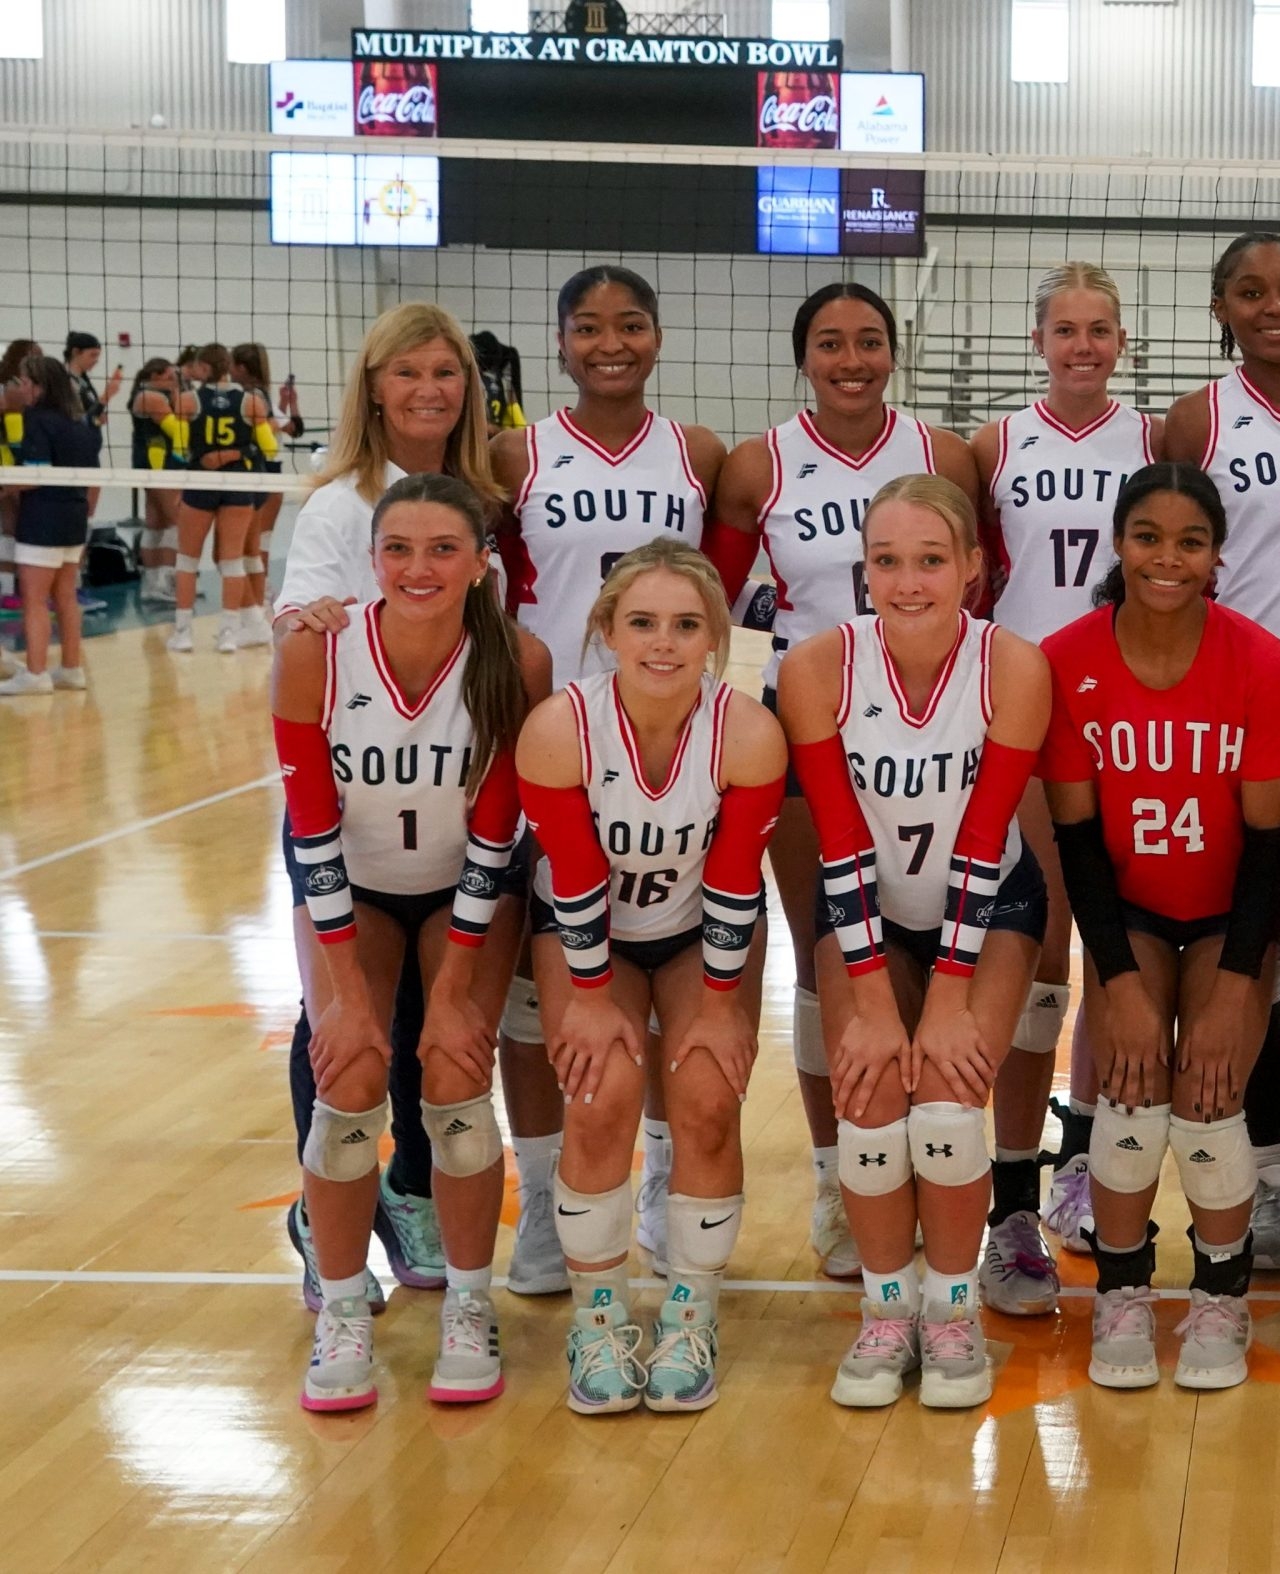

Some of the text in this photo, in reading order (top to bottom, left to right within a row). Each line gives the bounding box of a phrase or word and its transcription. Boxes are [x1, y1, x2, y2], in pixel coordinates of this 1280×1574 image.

[355, 32, 837, 67] MULTIPLEX AT CRAMTON BOWL
[356, 85, 435, 124] Coca-Cola
[759, 95, 838, 132] Coca-Cola
[758, 196, 836, 214] GUARDIAN
[205, 415, 236, 446] 15
[1011, 468, 1128, 507] SOUT
[545, 489, 684, 532] SOUTH
[794, 498, 870, 541] SOU
[1049, 529, 1099, 587] 17
[1083, 720, 1244, 774] SOUTH
[847, 748, 979, 798] SOUTH
[398, 810, 417, 850] 1
[593, 811, 719, 856] OUTH
[1132, 798, 1205, 855] 24
[898, 822, 934, 875] 7
[618, 868, 678, 908] 16
